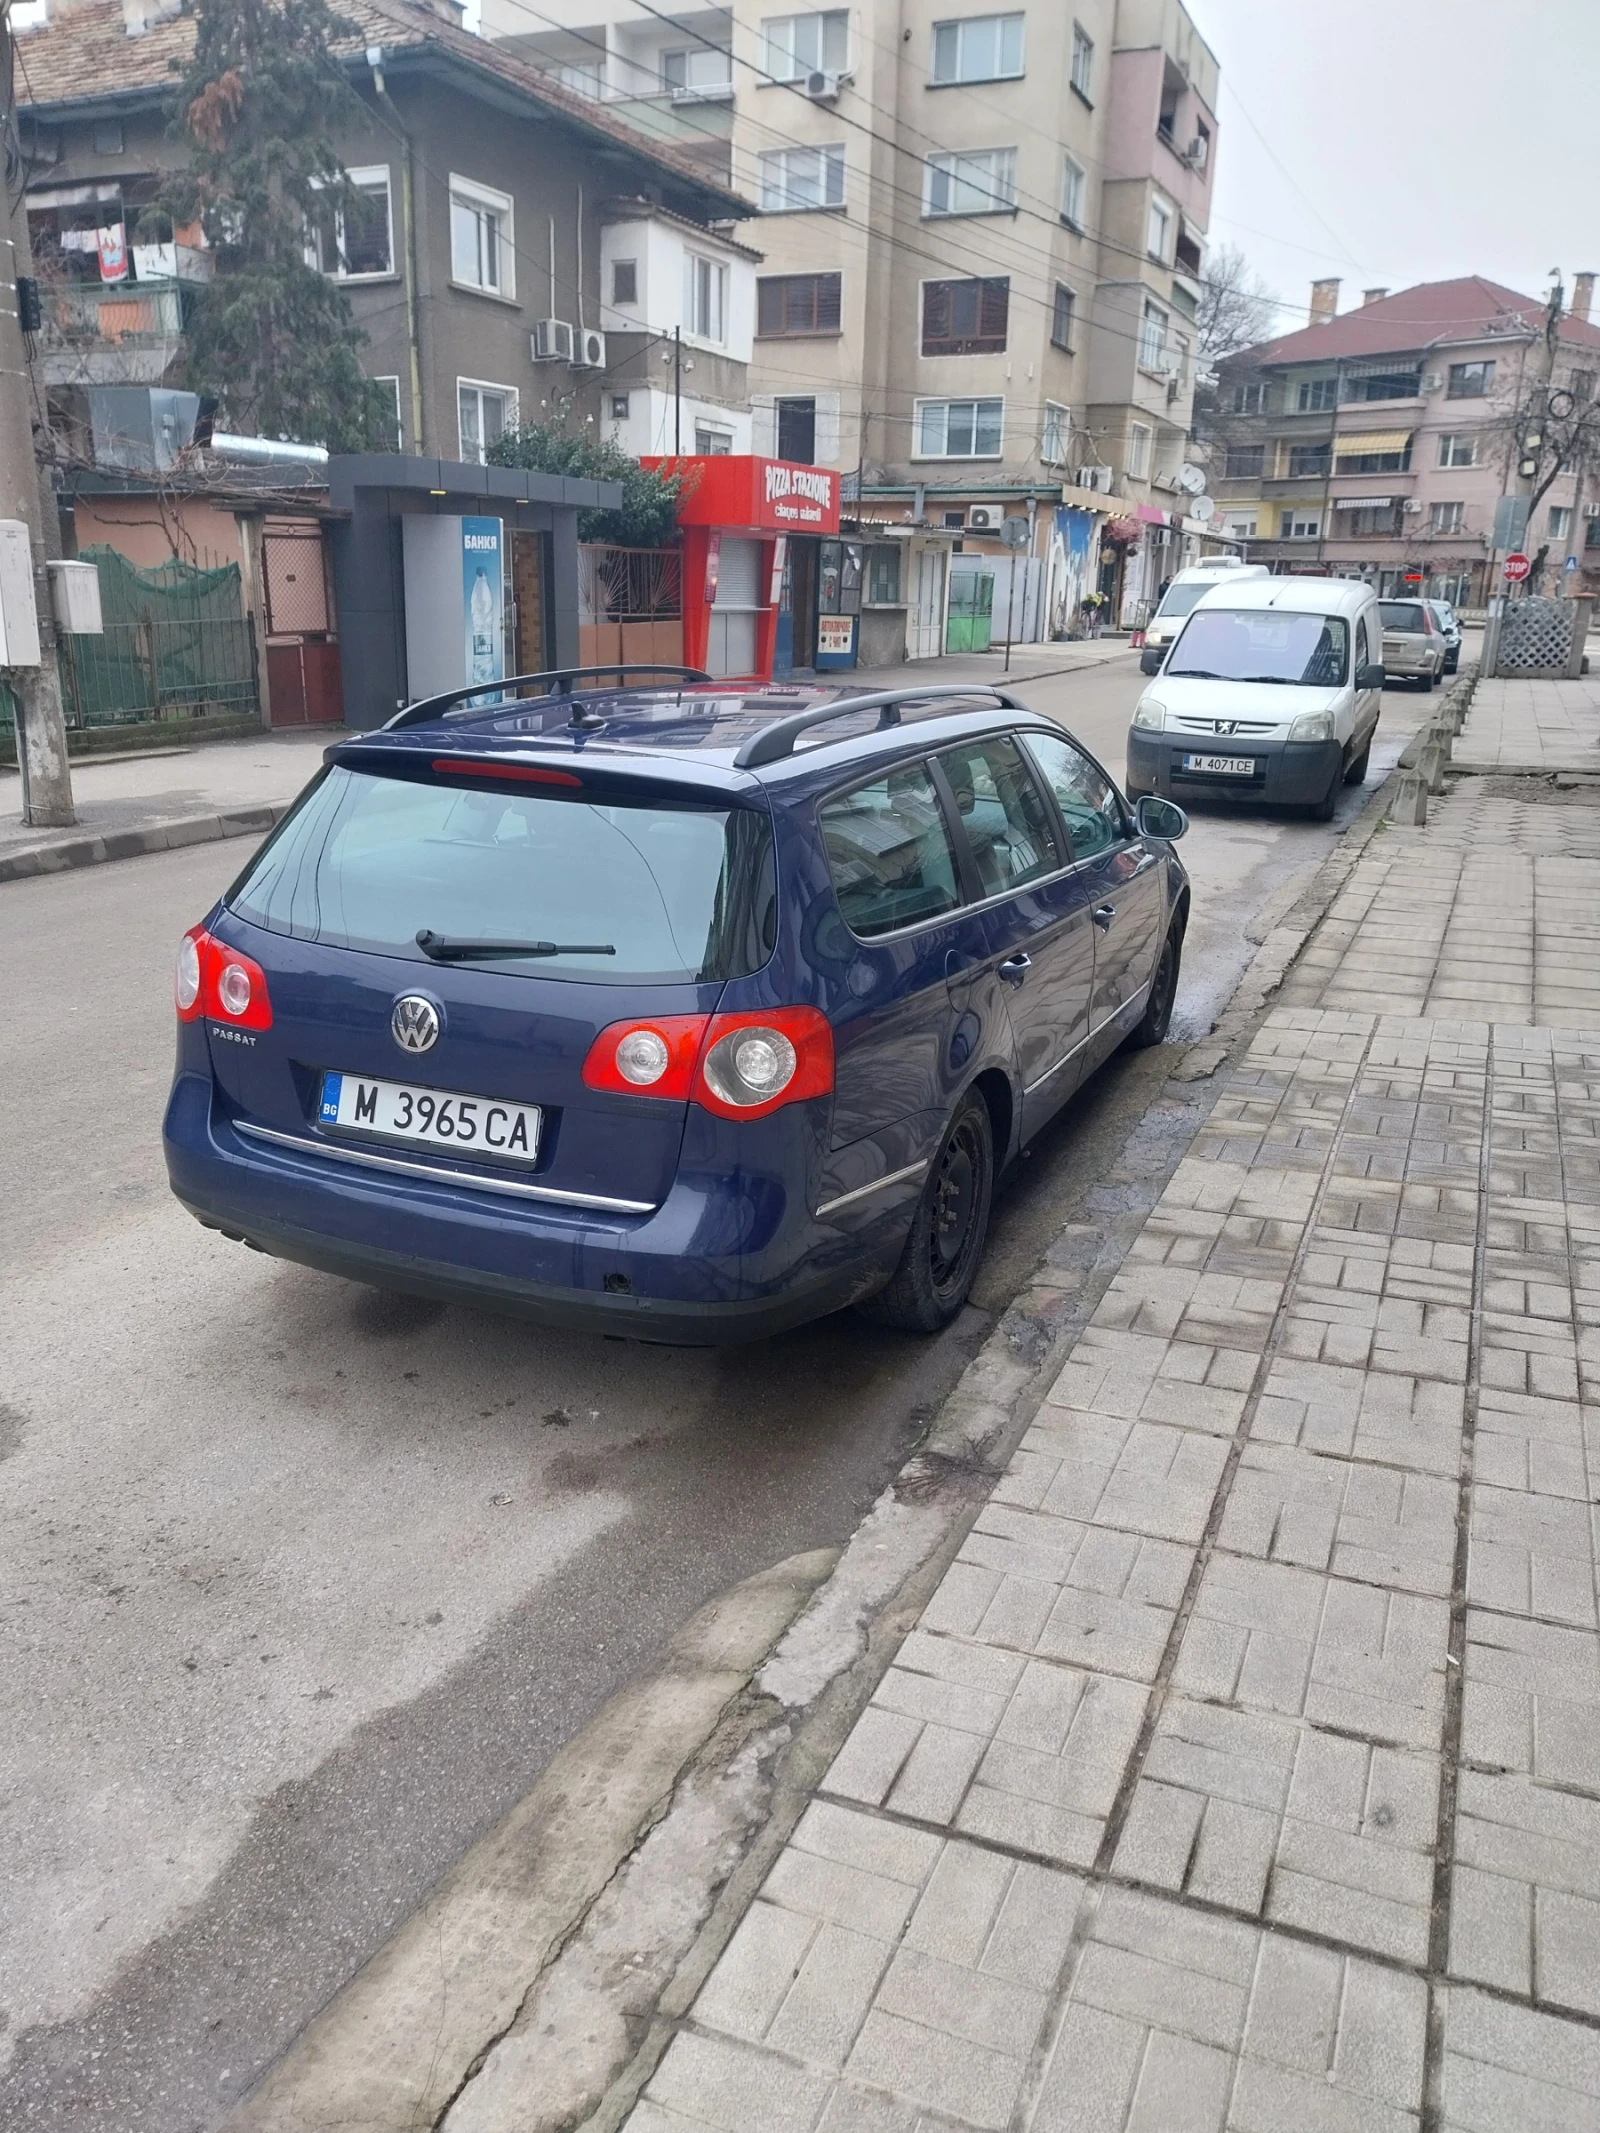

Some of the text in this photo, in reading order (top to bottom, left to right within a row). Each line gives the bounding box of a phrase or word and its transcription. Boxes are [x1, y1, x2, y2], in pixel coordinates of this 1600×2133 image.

[765, 465, 831, 509] PIZZA STAZIONE
[464, 534, 497, 550] БАНКЯ
[1504, 562, 1528, 573] STOP
[212, 1027, 256, 1047] PASSAT
[323, 1103, 337, 1116] BG
